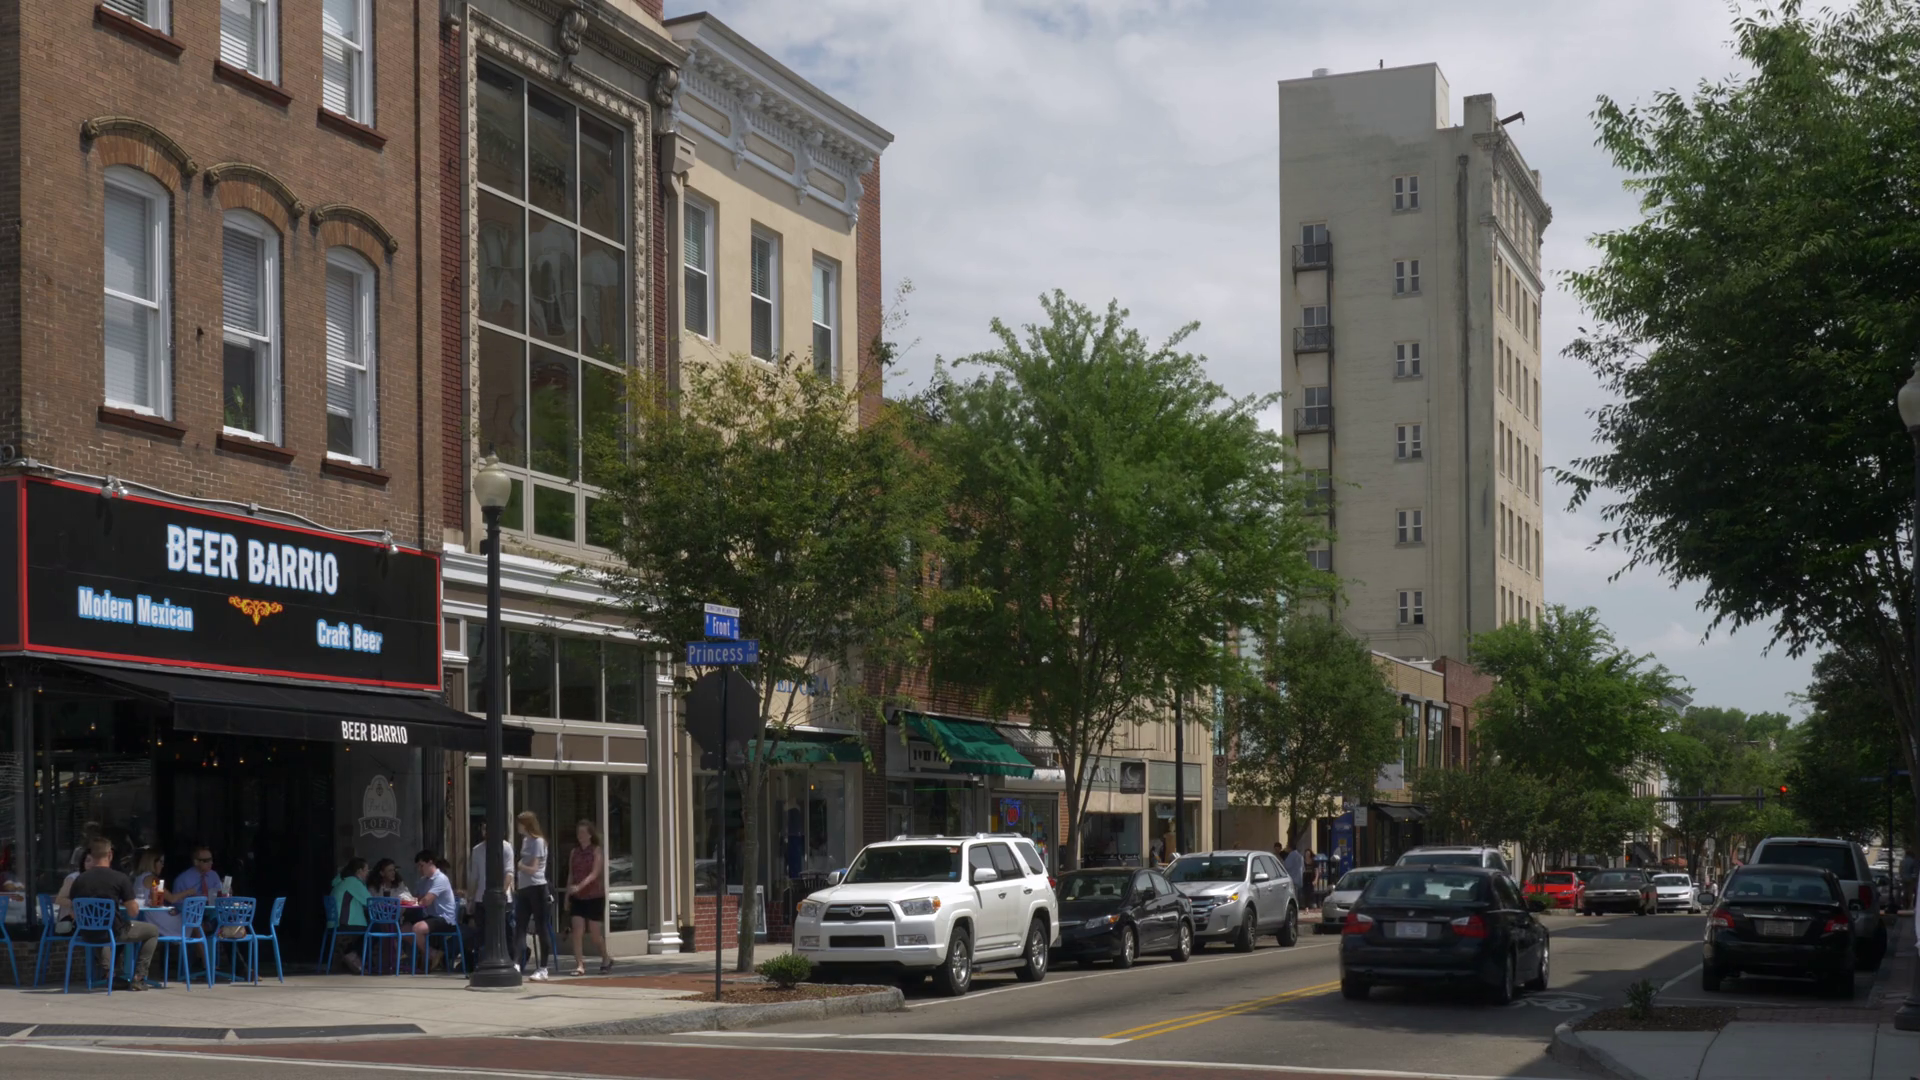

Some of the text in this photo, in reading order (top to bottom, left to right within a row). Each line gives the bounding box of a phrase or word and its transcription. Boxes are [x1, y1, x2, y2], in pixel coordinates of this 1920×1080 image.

[166, 524, 338, 595] BEER BARRIO
[78, 586, 193, 631] Modern Mexican
[317, 619, 383, 653] Craft Beer
[713, 616, 730, 636] Front
[689, 645, 743, 663] Princess
[341, 720, 408, 744] BEER BARRIO
[363, 818, 397, 832] LOFTS
